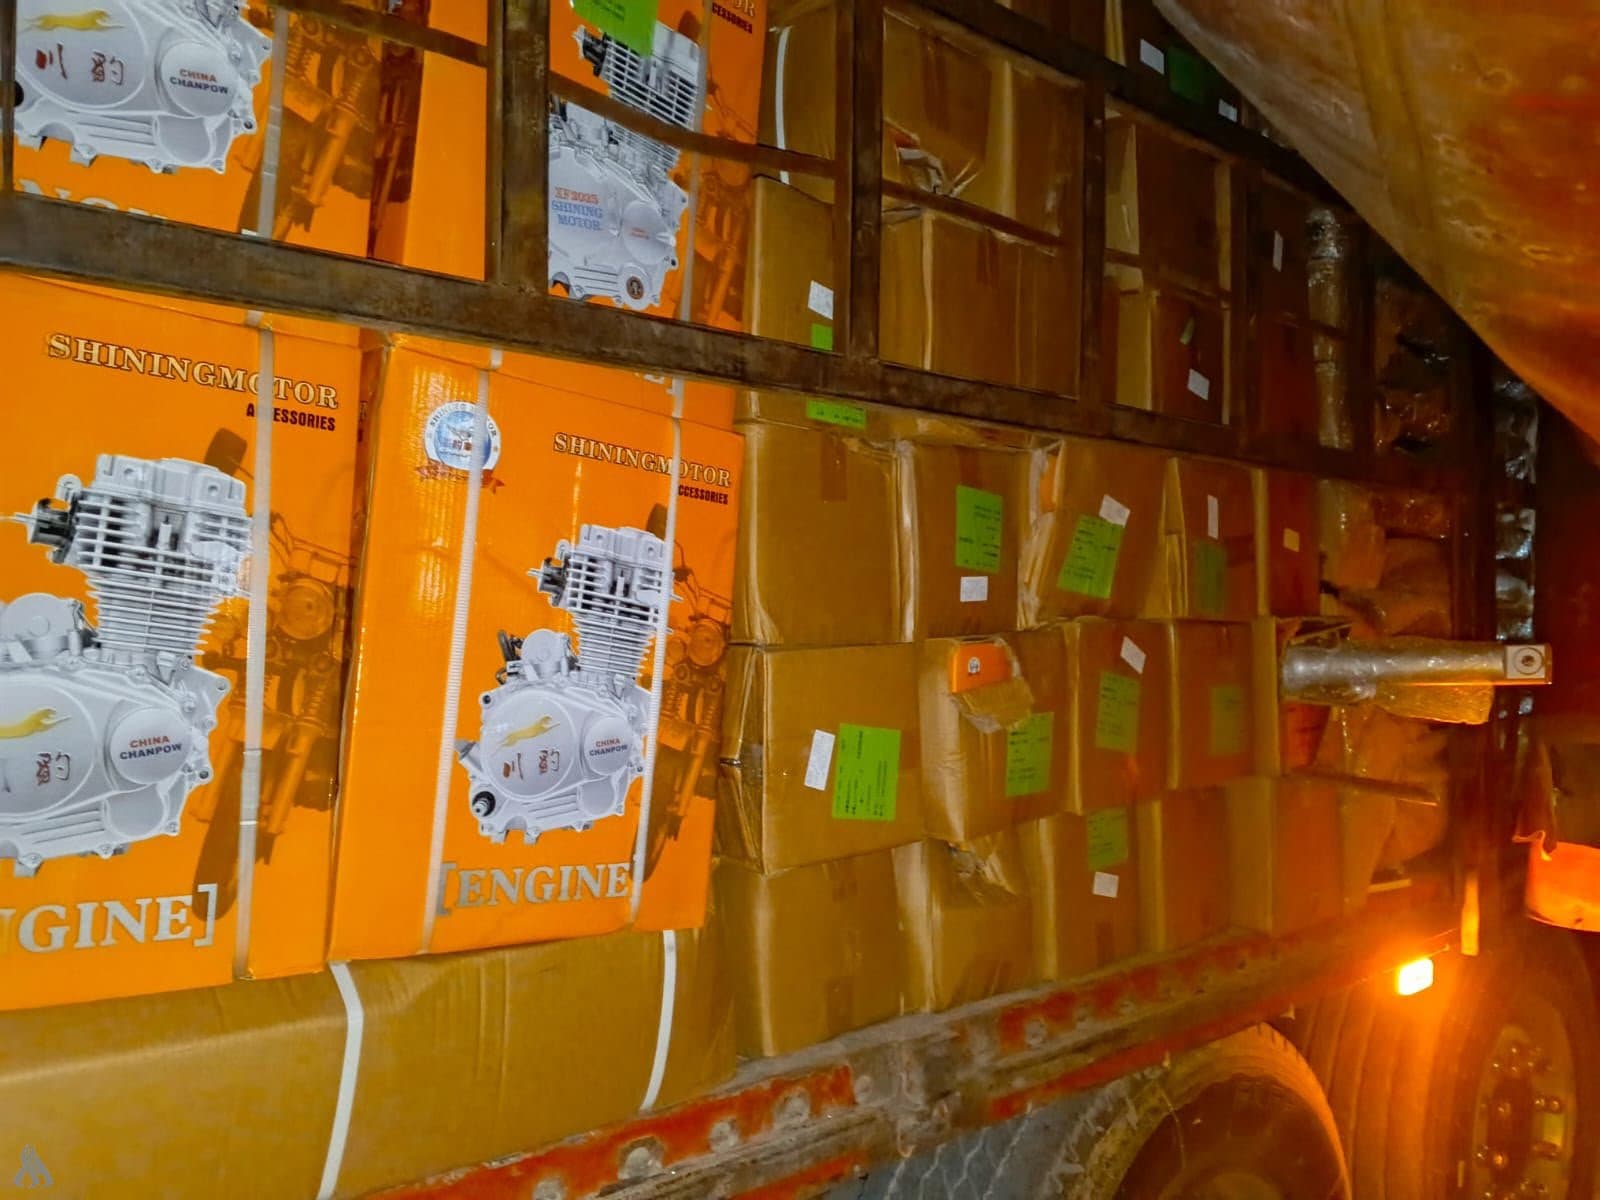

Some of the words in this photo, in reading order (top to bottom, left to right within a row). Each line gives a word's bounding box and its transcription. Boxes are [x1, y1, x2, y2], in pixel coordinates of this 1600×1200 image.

[179, 68, 217, 83] CHINA
[169, 76, 229, 95] CHANPOW
[551, 200, 603, 219] SHINING
[557, 214, 602, 231] MOTOR
[246, 402, 336, 432] AESSORIES
[678, 484, 729, 505] CCESSORIES
[130, 735, 171, 749] CHINA
[588, 744, 628, 757] CHANPOW
[595, 737, 621, 748] CHINA
[119, 743, 183, 760] CHANPOW
